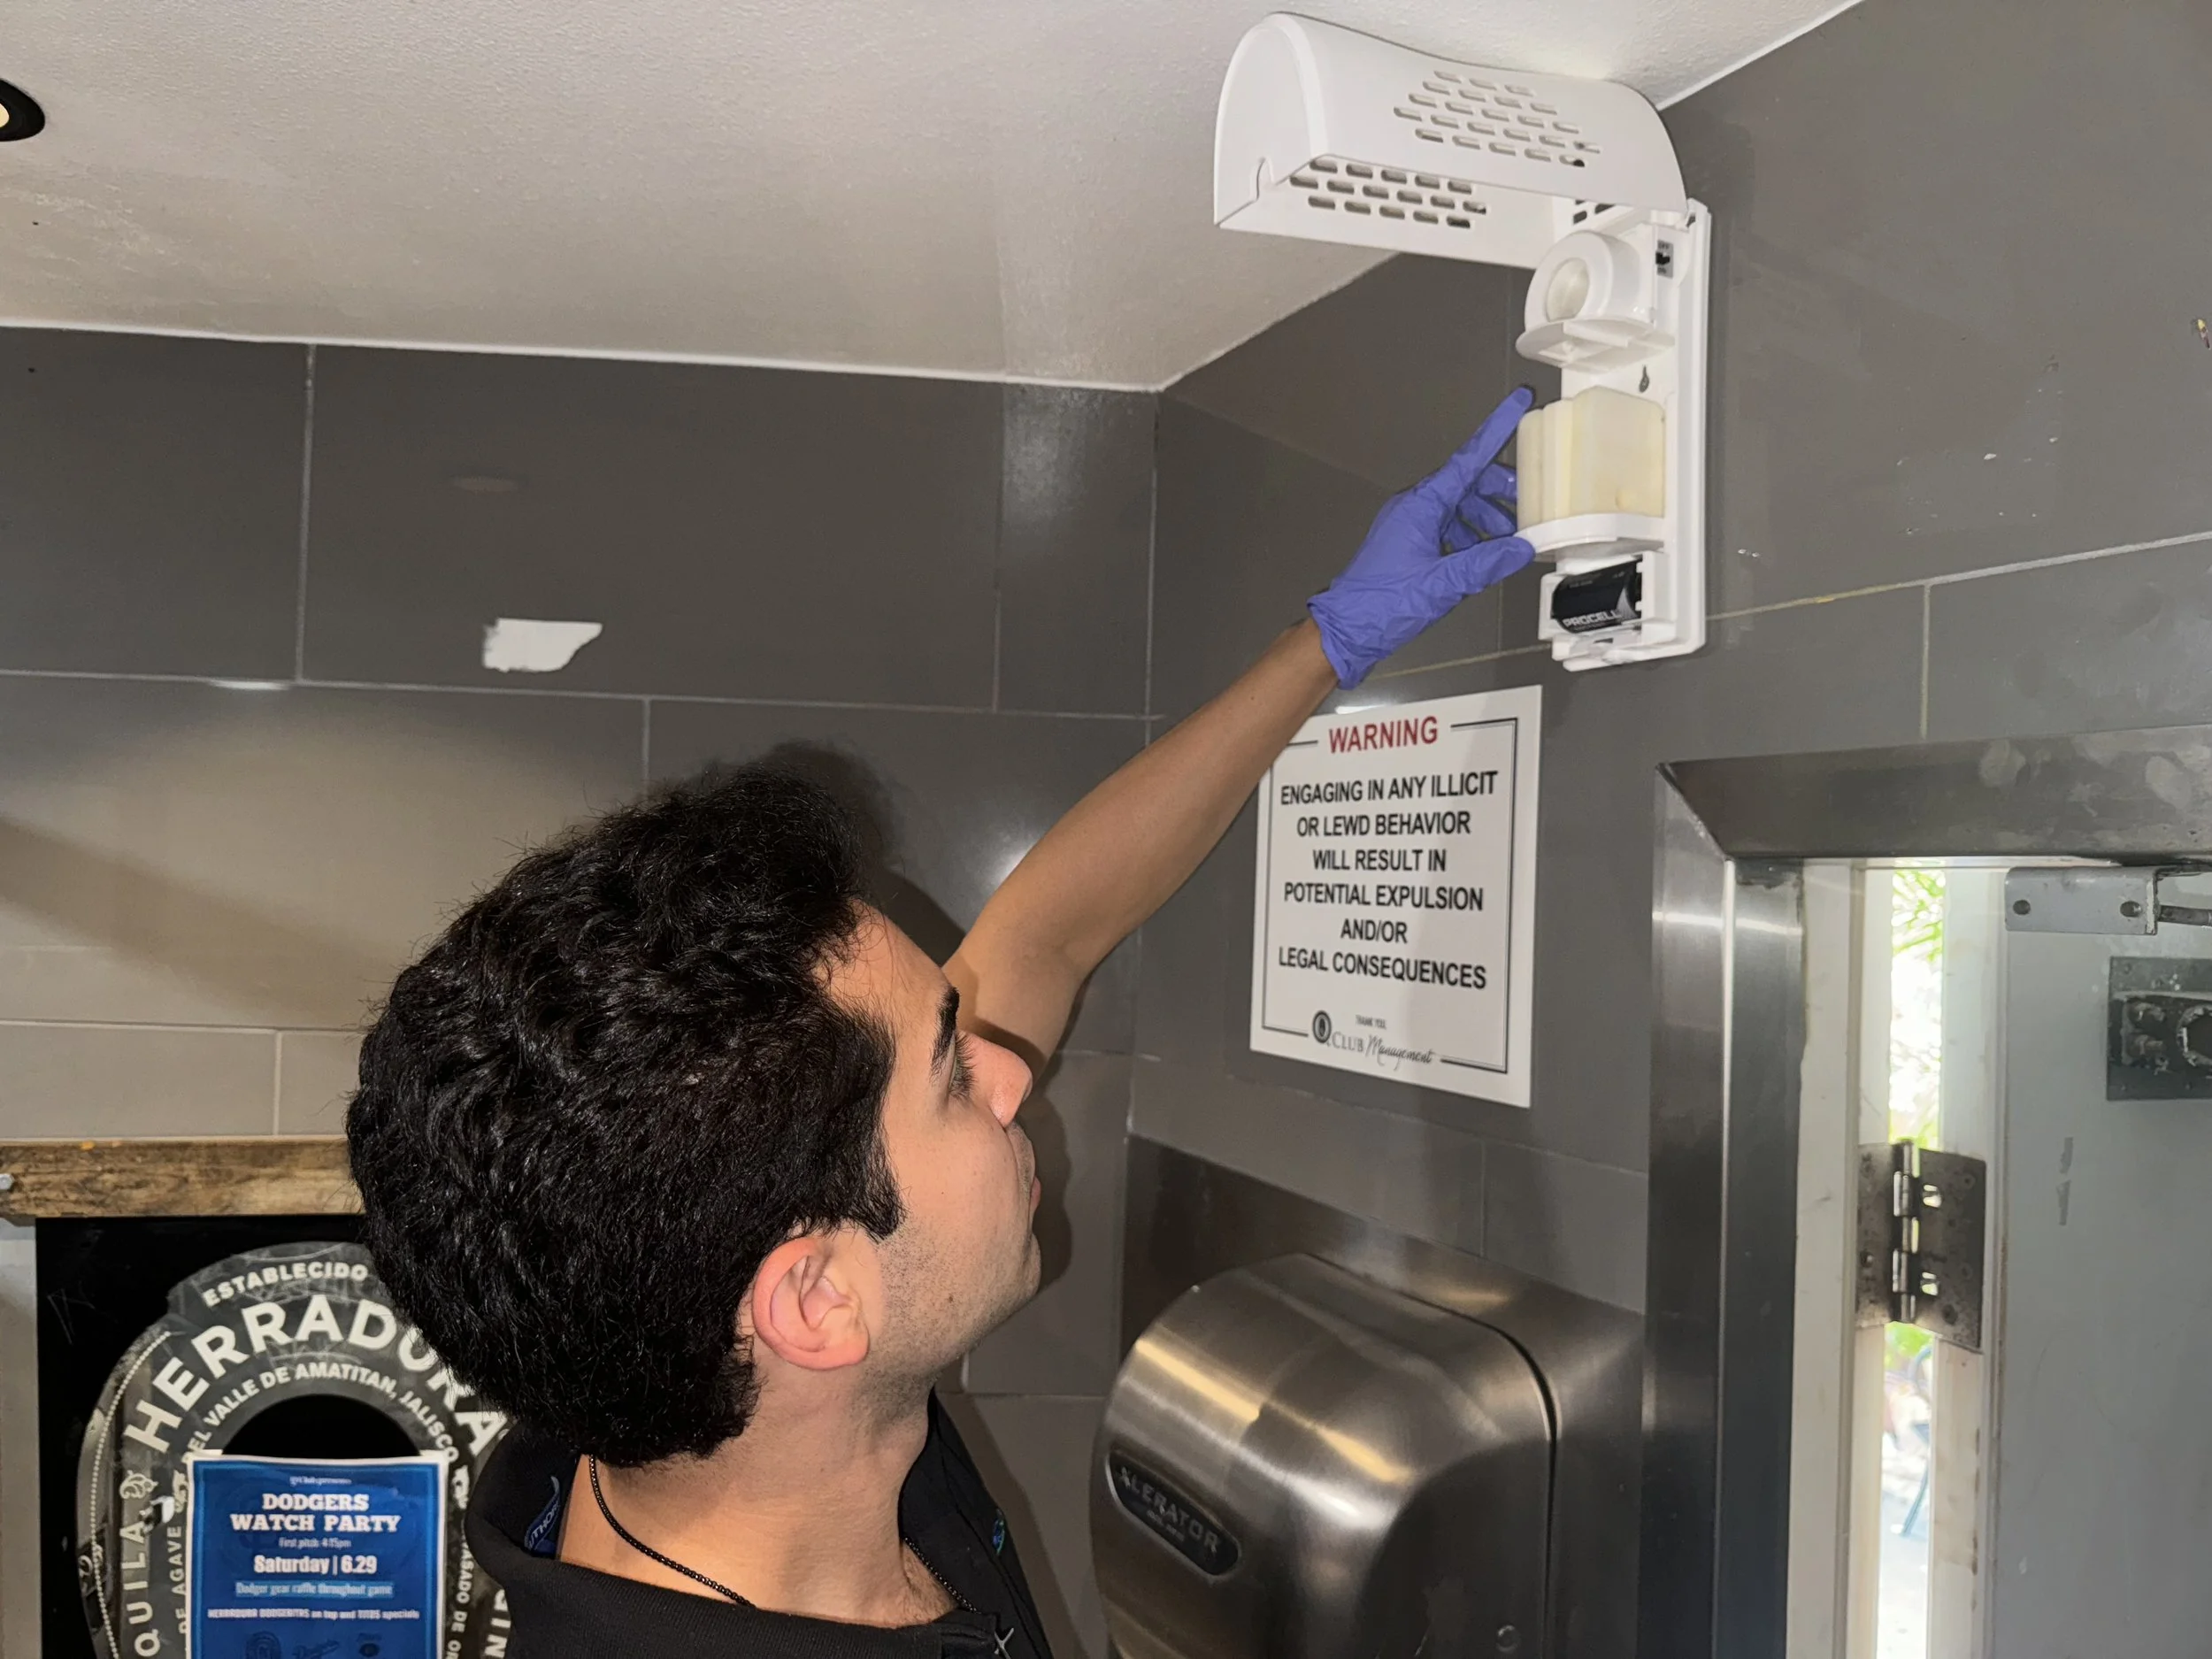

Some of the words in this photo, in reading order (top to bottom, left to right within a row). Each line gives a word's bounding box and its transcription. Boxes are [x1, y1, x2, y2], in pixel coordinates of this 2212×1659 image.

[1563, 610, 1622, 627] PROCELL
[1329, 716, 1439, 753] WARNING
[1280, 779, 1363, 805] ENGAGING
[1367, 778, 1385, 801] IN
[1387, 775, 1426, 799] ANY
[1431, 771, 1499, 797] ILLICIT
[1296, 816, 1320, 837] OR
[1323, 813, 1371, 836] LEWD
[1375, 810, 1471, 836] BEHAVIOR
[1312, 849, 1351, 871] WILL
[1355, 849, 1424, 872] RESULT
[1428, 849, 1447, 872] IN
[1284, 882, 1371, 906] POTENTIAL
[1376, 885, 1484, 910] EXPULSION
[1340, 918, 1408, 944] AND/OR
[1279, 947, 1329, 972] LEGAL
[1333, 952, 1486, 989] CONSEQUENCES
[1355, 1015, 1372, 1027] THANK
[1365, 1034, 1434, 1071] Management
[202, 1261, 368, 1308] ESTABLECIDO
[203, 1379, 260, 1428] VALLE
[259, 1366, 291, 1389] DE
[398, 1391, 459, 1462] JALISCO
[262, 1494, 369, 1511] DODGERS
[229, 1514, 315, 1532] WATCH
[324, 1515, 401, 1532] PARTY
[166, 1526, 187, 1595] AGAVE
[253, 1555, 330, 1575] Saturday
[341, 1555, 378, 1574] 6.29
[451, 1610, 468, 1633] DE
